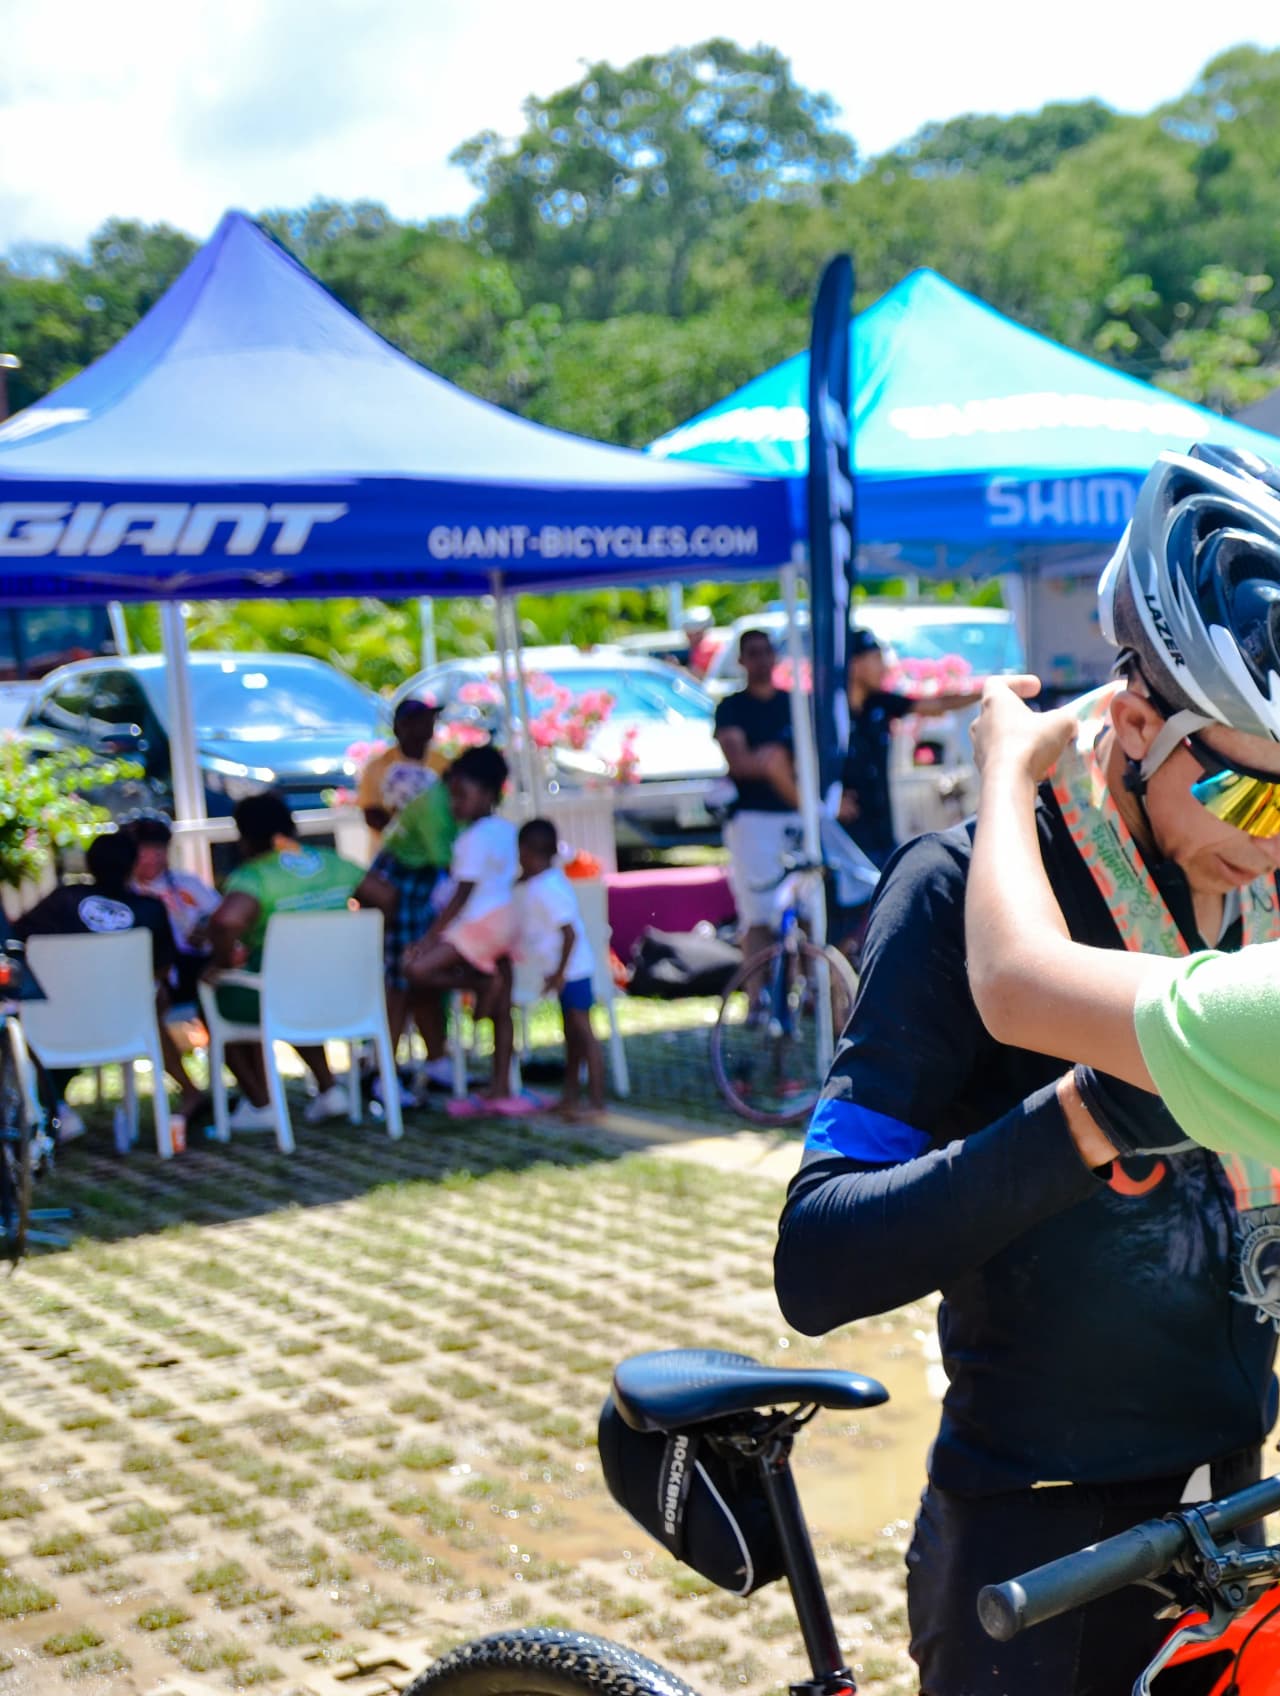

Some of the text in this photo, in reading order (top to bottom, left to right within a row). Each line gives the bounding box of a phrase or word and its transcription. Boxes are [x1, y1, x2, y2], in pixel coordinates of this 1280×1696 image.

[0, 501, 349, 557] GIANT
[428, 524, 758, 559] GIANT-BICYCLES.COM
[1144, 594, 1186, 668] LAZER
[664, 1435, 689, 1536] ROCKBROS
